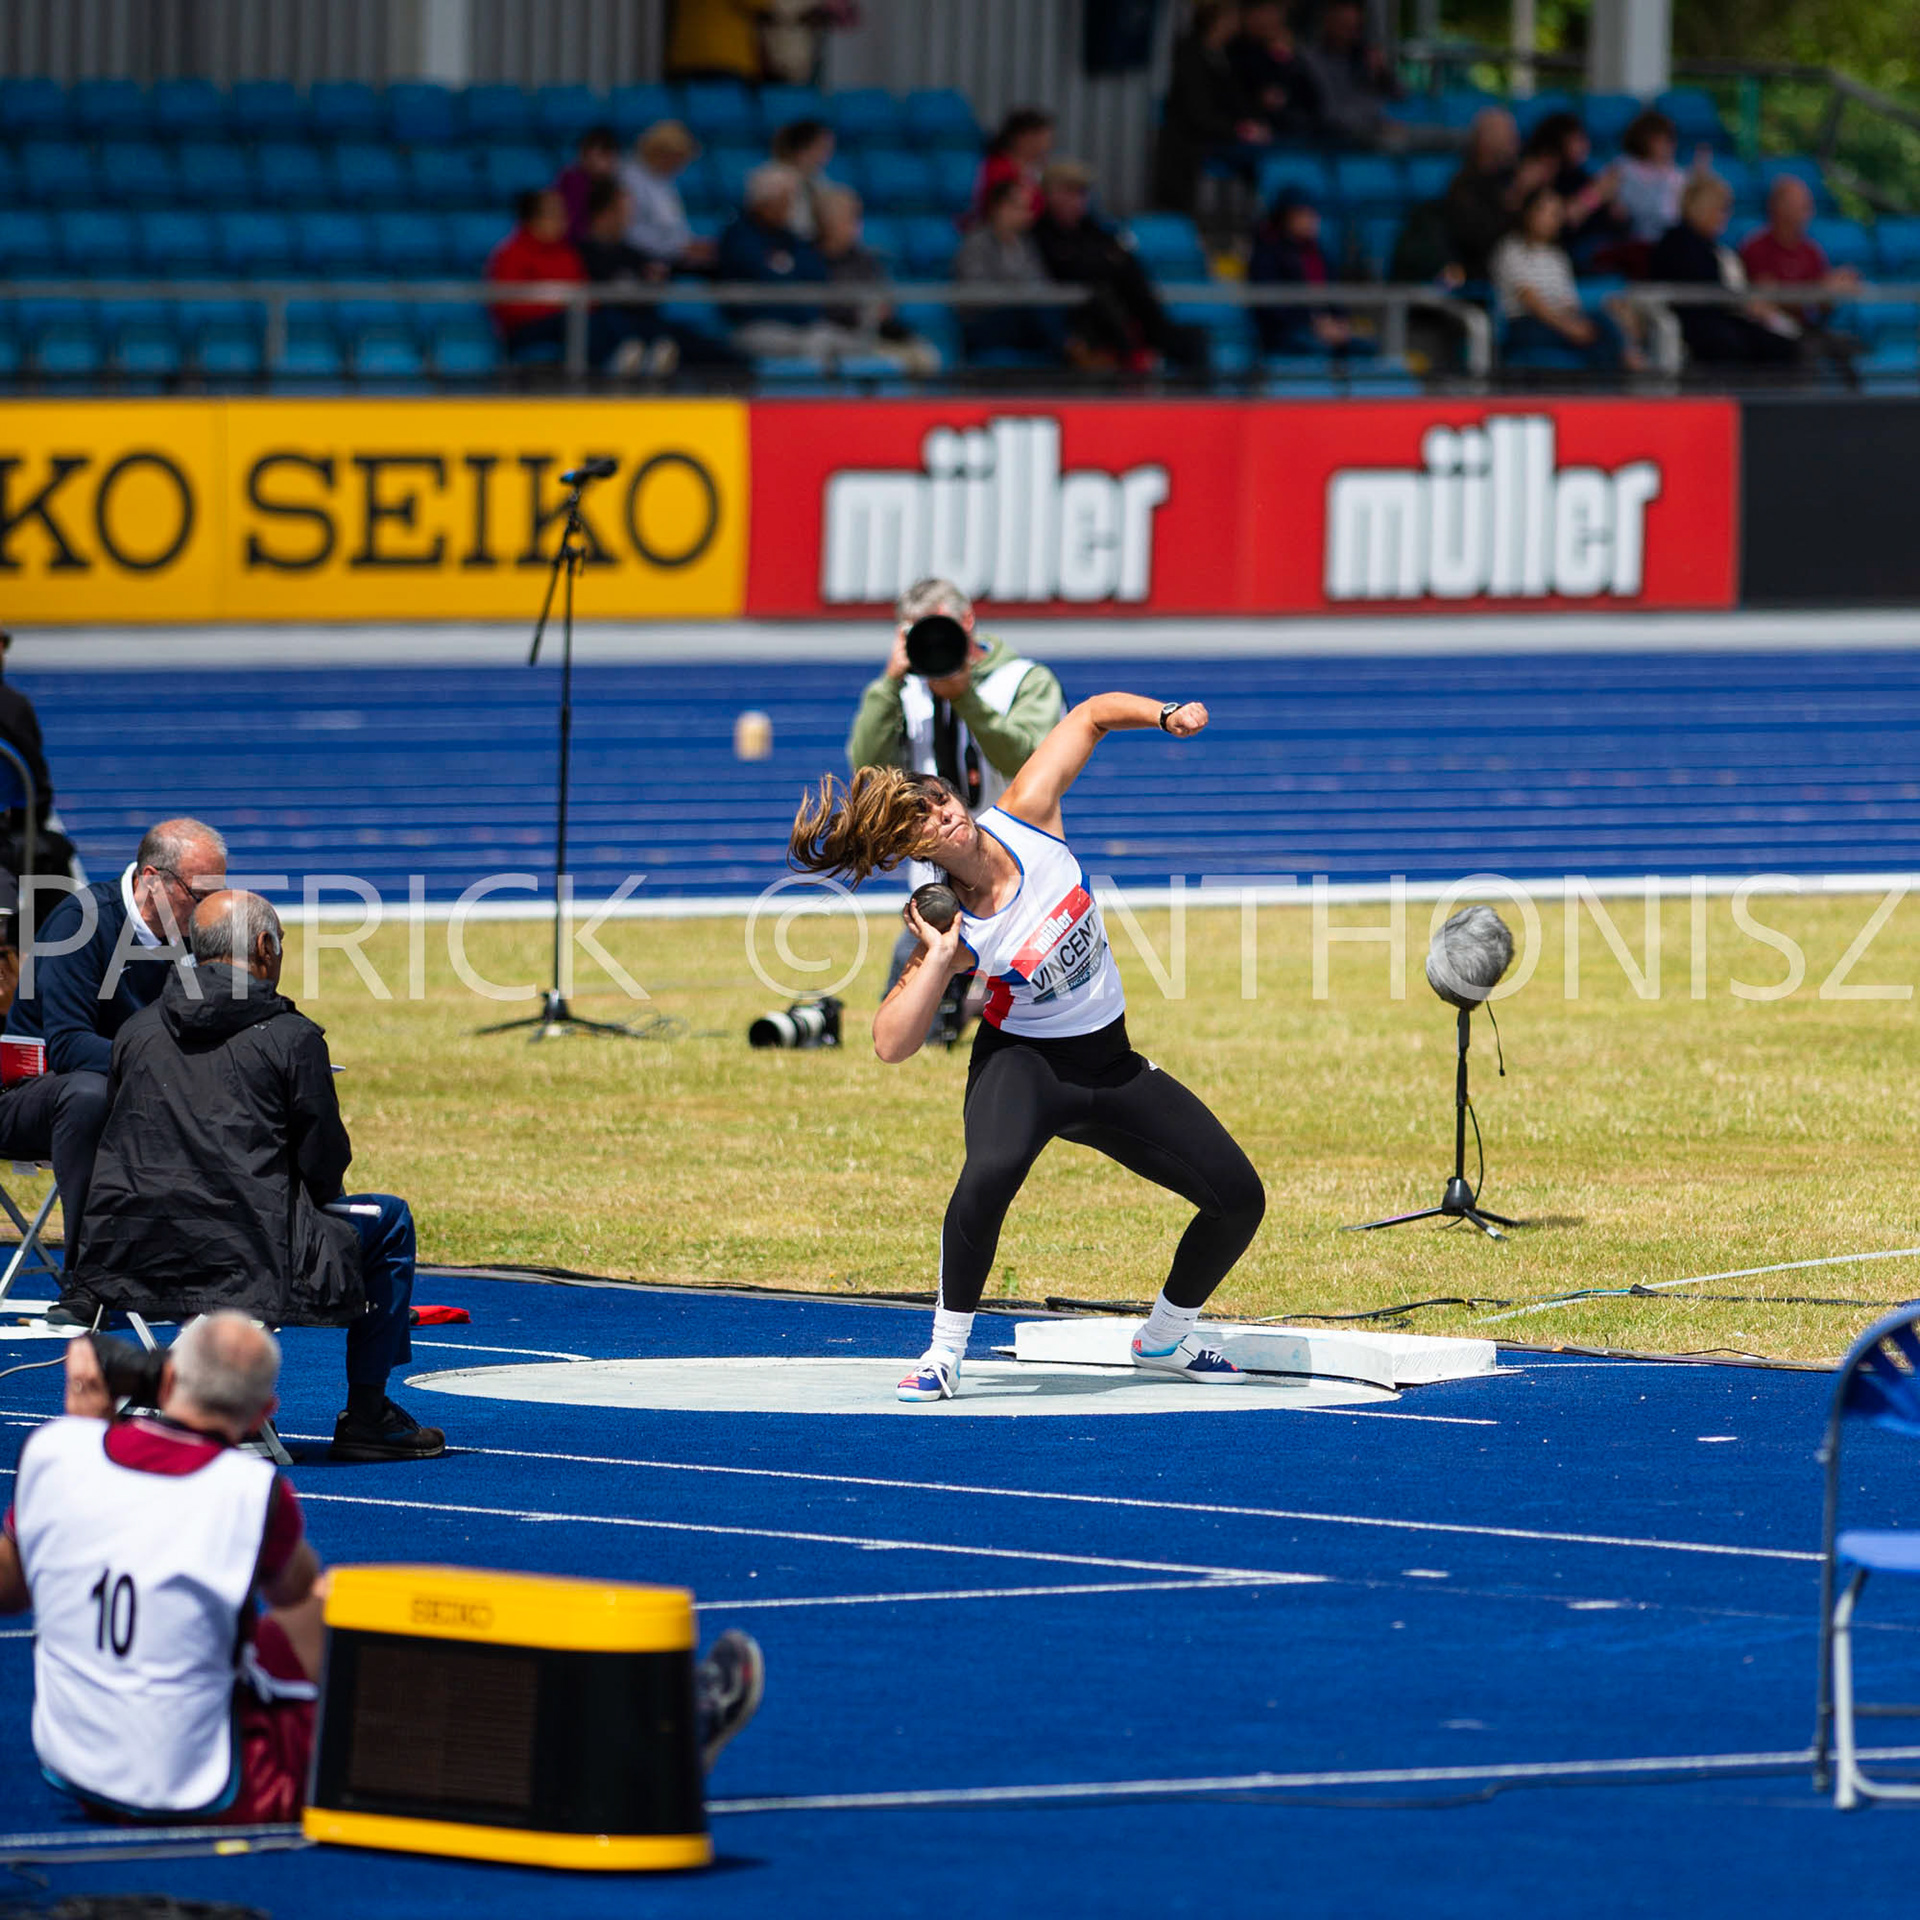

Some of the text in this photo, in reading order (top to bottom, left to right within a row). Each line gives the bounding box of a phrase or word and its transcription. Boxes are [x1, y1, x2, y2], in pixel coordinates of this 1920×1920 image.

[244, 452, 720, 575] SEIKO
[820, 414, 1170, 603] müller
[1323, 413, 1662, 600] müller
[1032, 908, 1096, 991] VINCENT
[91, 1568, 136, 1657] 10
[411, 1596, 494, 1628] SEIKO
